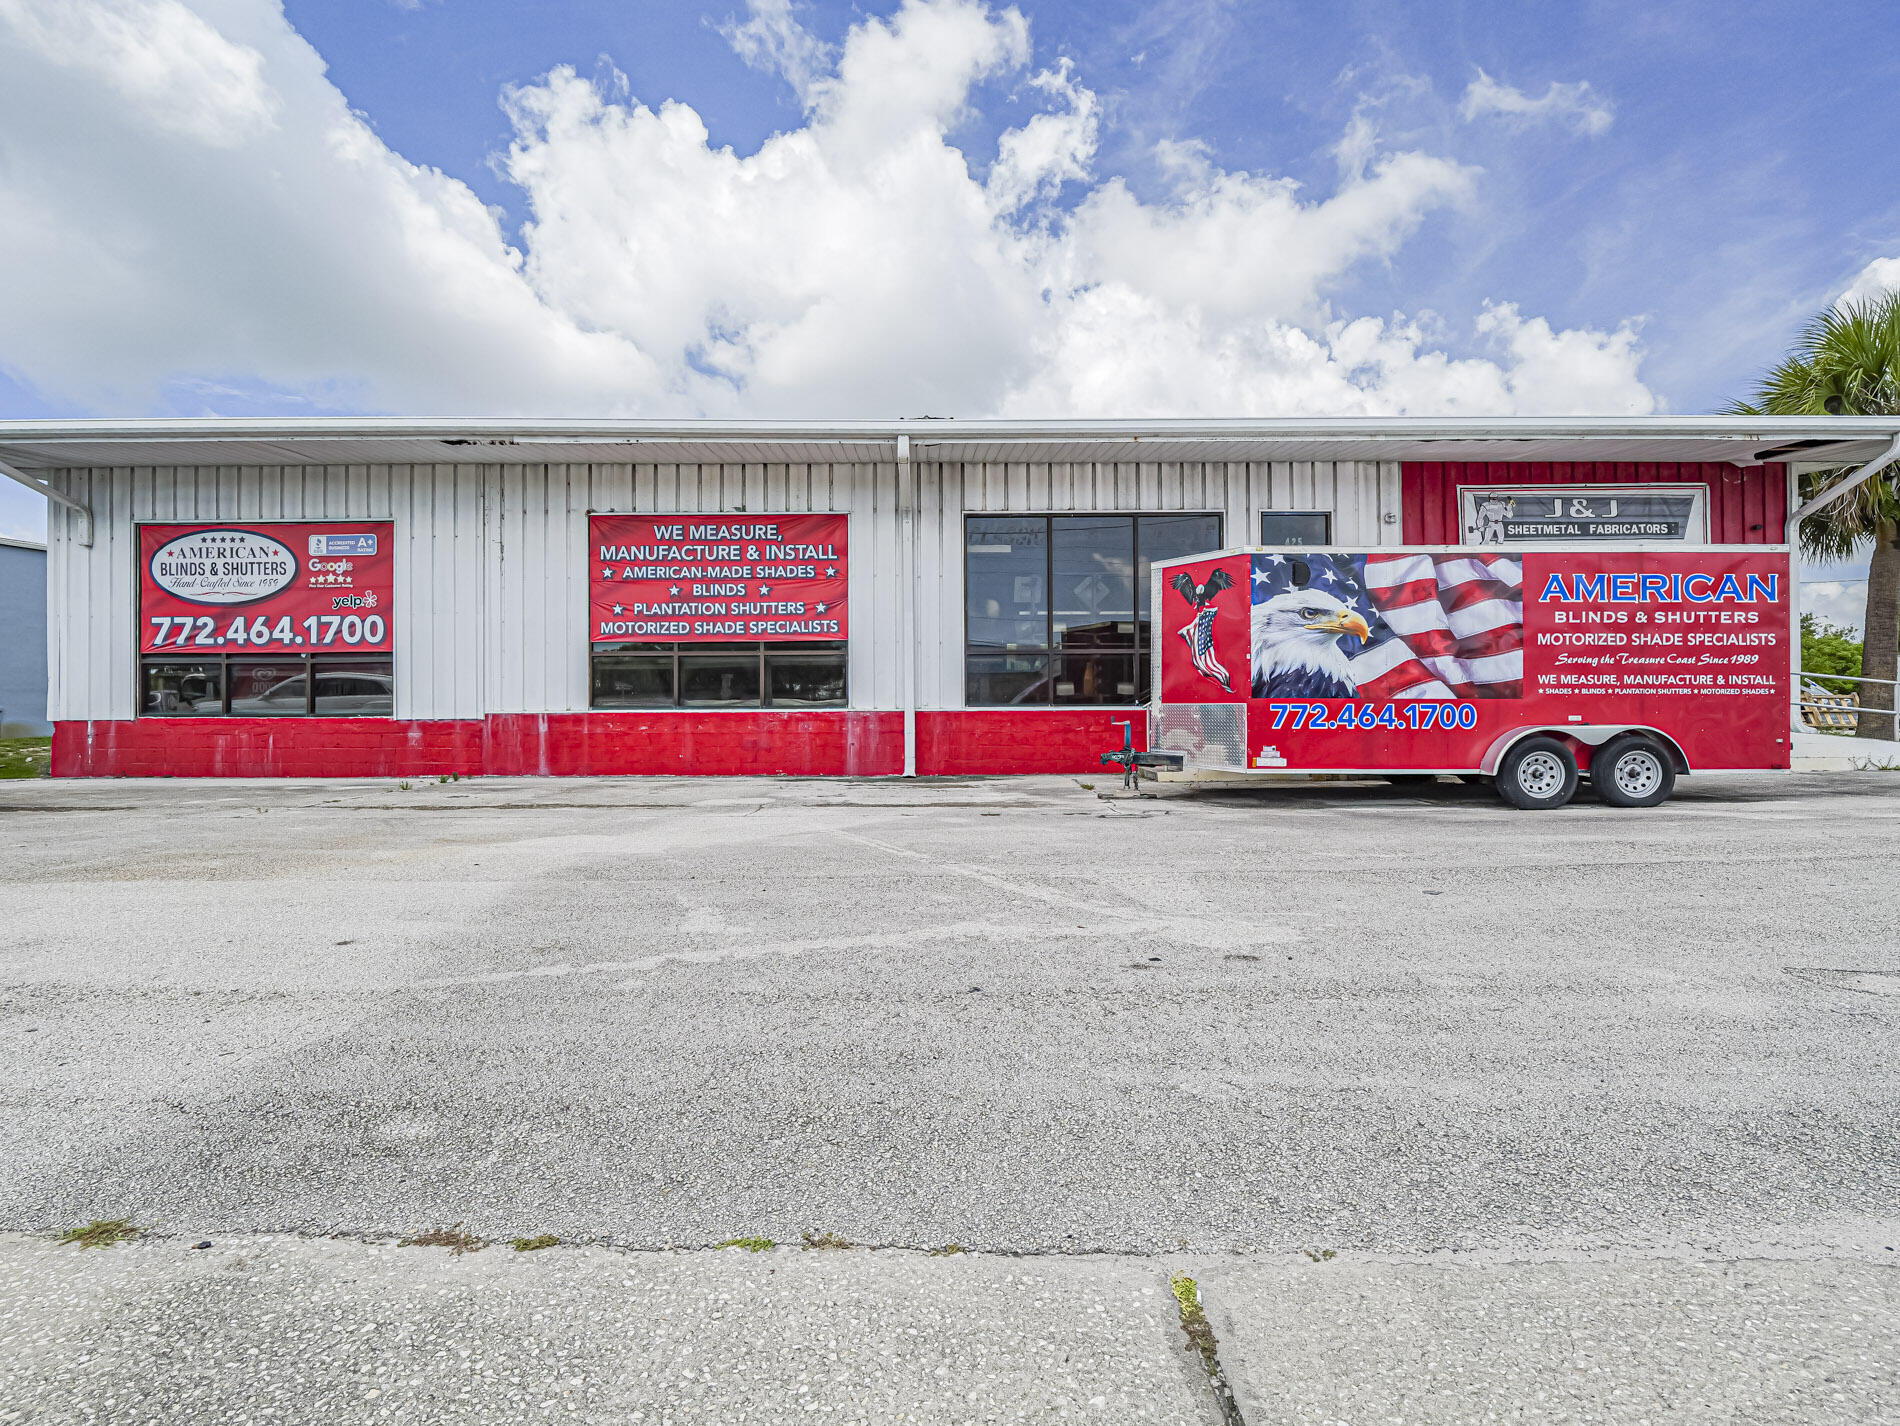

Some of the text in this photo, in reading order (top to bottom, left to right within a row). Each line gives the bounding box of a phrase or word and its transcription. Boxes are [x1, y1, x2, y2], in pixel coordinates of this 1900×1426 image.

[1545, 498, 1619, 518] J & J
[654, 524, 783, 541] WE MEASURE,
[1507, 524, 1668, 535] SHEETMETAL FABRICATORS
[358, 538, 373, 547] A+
[176, 546, 270, 559] AMERICAN
[600, 544, 839, 561] MANUFACTURE & INSTALL
[161, 562, 286, 576] BLINDS & SHUTTERS
[309, 558, 353, 574] Google
[622, 565, 815, 578] AMERICAN-MADE SHADES
[232, 578, 255, 588] Since
[258, 579, 278, 588] 1989
[1538, 573, 1779, 603] AMERICAN
[693, 584, 746, 596] BLINDS
[332, 594, 362, 609] yelp
[634, 603, 805, 615] PLANTATION SHUTTERS
[1555, 612, 1759, 623] BLINDS & SHUTTERS
[151, 615, 386, 645] 772.464.1700
[601, 620, 839, 634] MOTORIZED SHADE SPECIALISTS
[1537, 633, 1776, 645] MOTORIZED SHADE SPECIALISTS
[1554, 653, 1759, 666] Serving the Treasure Coast Since 1989
[1538, 675, 1775, 686] WE MEASURE, MANUFACTURE & INSTALL
[1270, 703, 1478, 730] 772.464.1700
